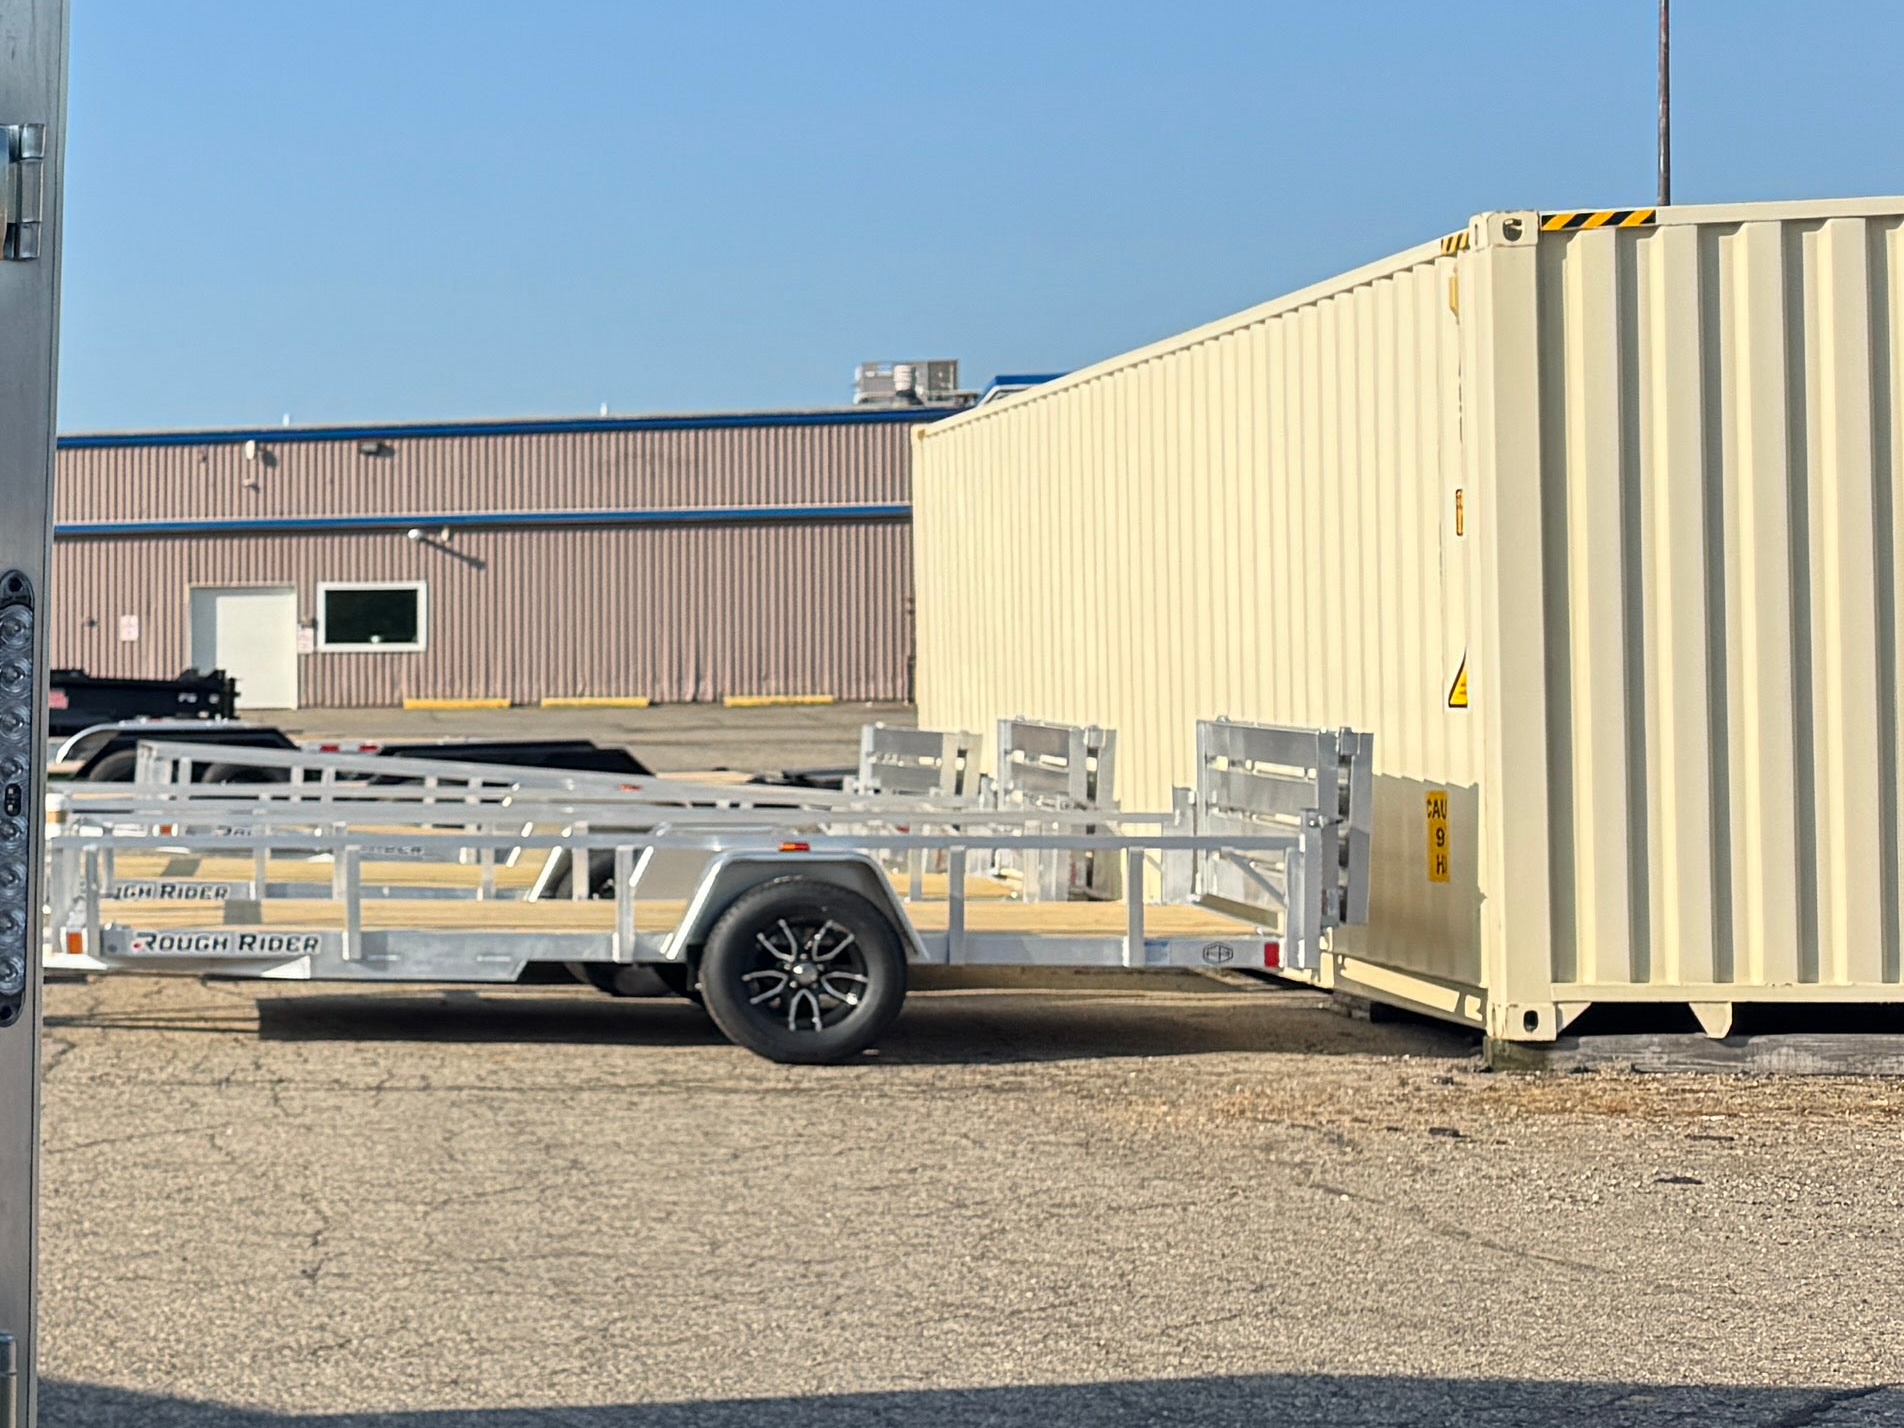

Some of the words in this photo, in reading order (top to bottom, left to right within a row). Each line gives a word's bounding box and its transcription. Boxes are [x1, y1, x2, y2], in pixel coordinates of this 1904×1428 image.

[160, 884, 229, 899] RIDER
[140, 932, 228, 952] ROUGH
[239, 933, 320, 952] RIDER
